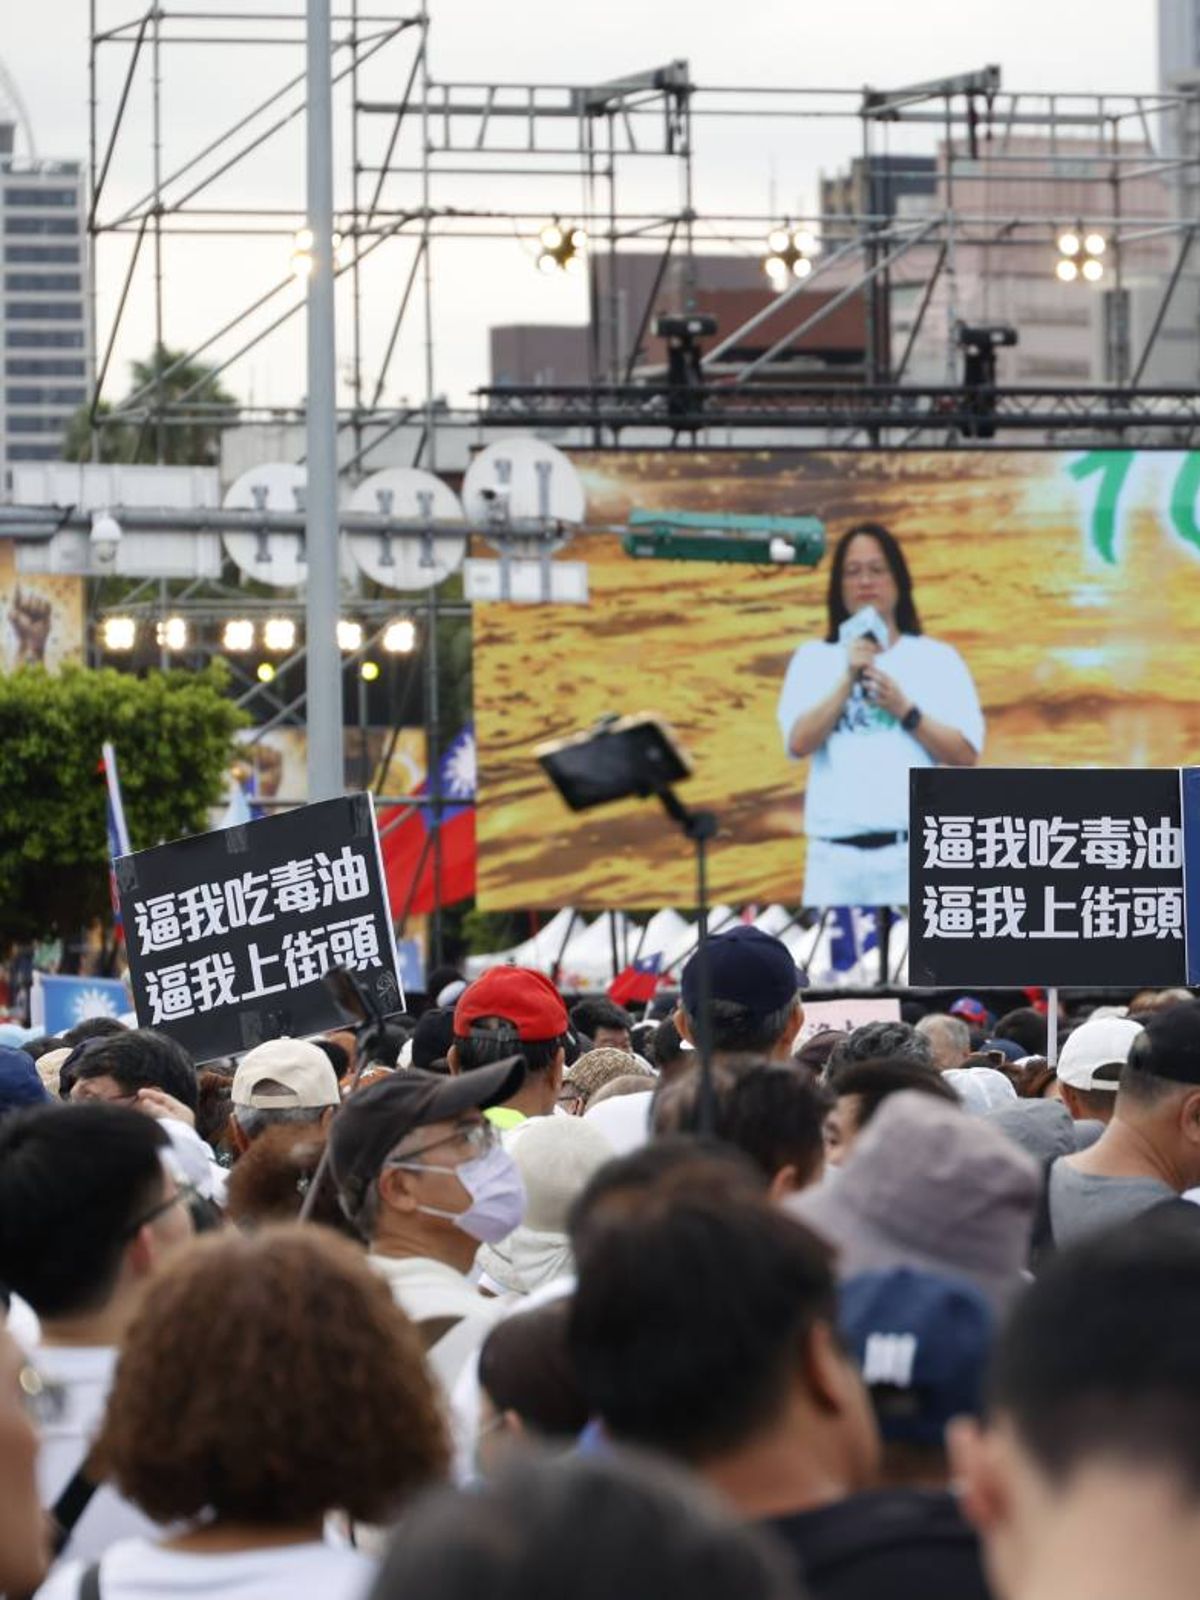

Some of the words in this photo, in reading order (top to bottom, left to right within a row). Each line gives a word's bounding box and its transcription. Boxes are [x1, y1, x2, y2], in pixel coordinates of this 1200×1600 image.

[923, 816, 1182, 869] 逼我吃毒油
[134, 846, 371, 955] 逼我吃毒油
[923, 885, 1183, 939] 逼我上街頭
[145, 913, 383, 1025] 逼我上街頭
